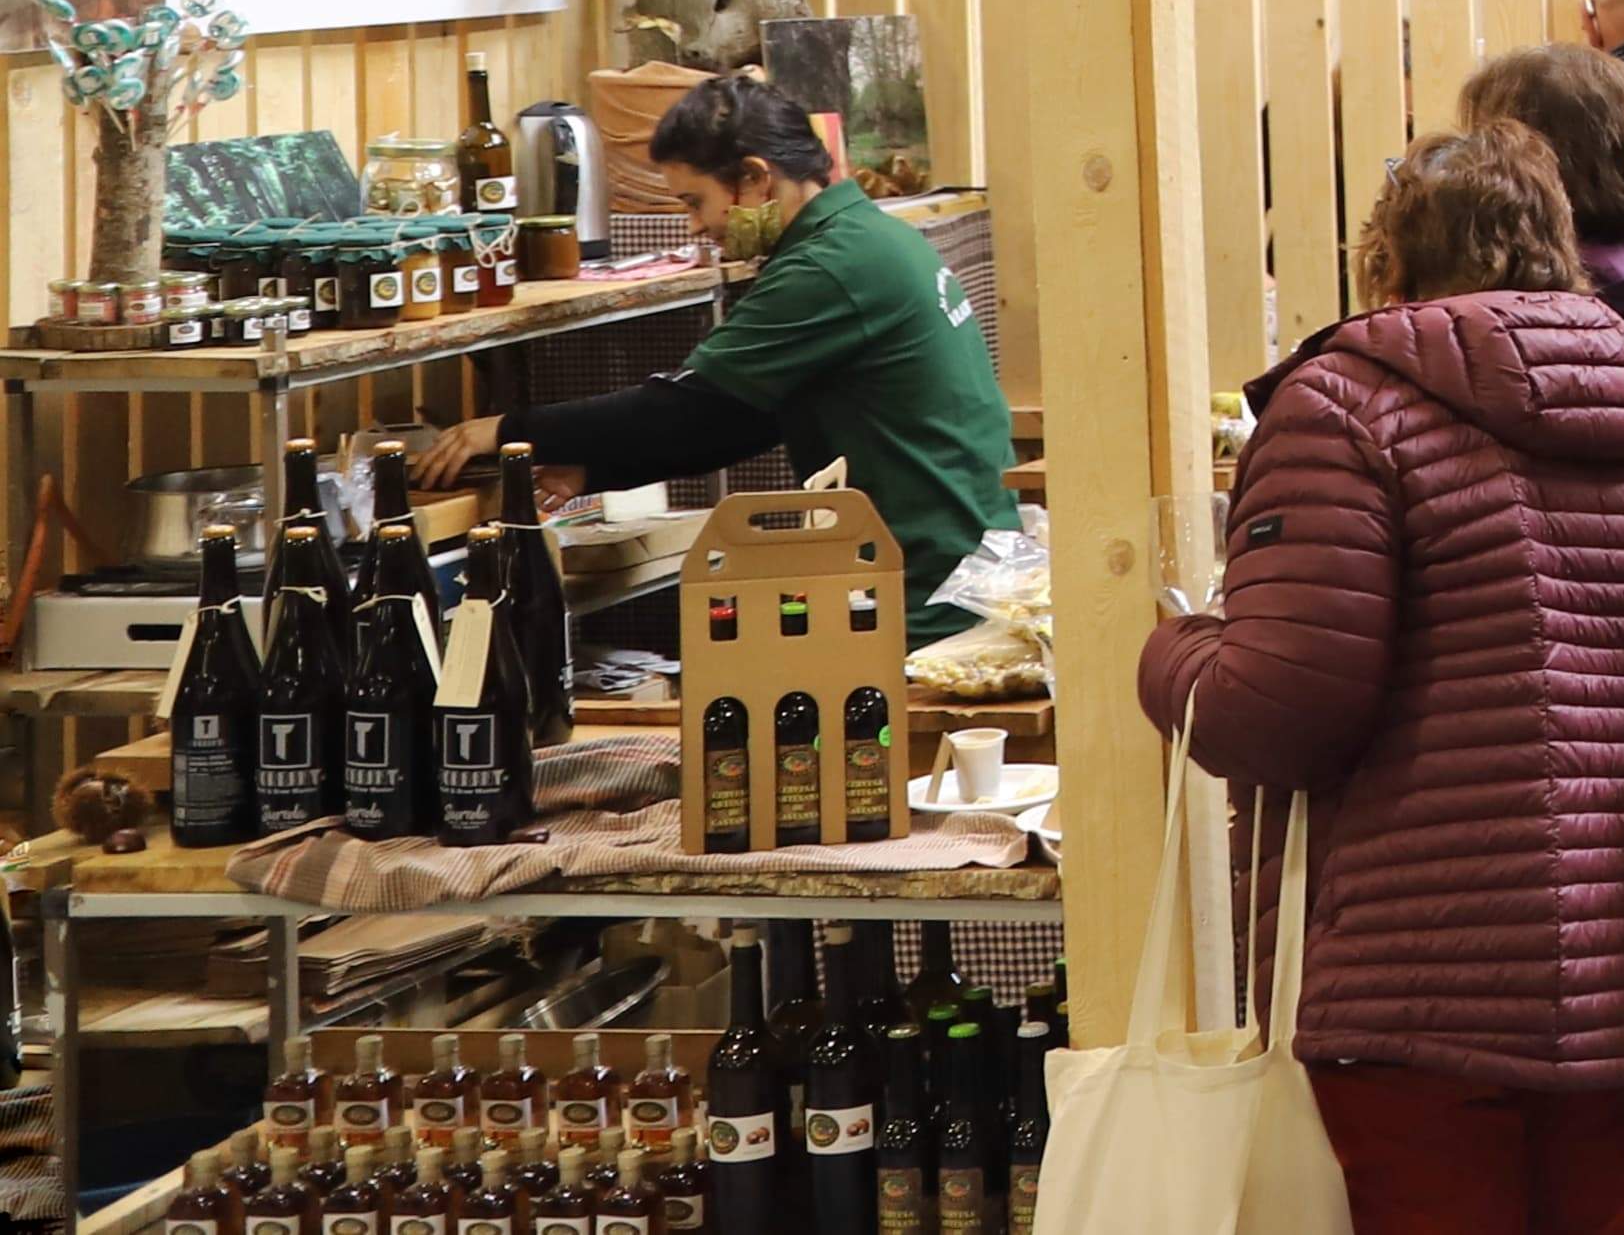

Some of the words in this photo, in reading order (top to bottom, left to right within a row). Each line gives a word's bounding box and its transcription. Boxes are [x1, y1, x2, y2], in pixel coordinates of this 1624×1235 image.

[271, 723, 296, 761] T
[353, 721, 376, 759] T
[455, 723, 481, 761] T
